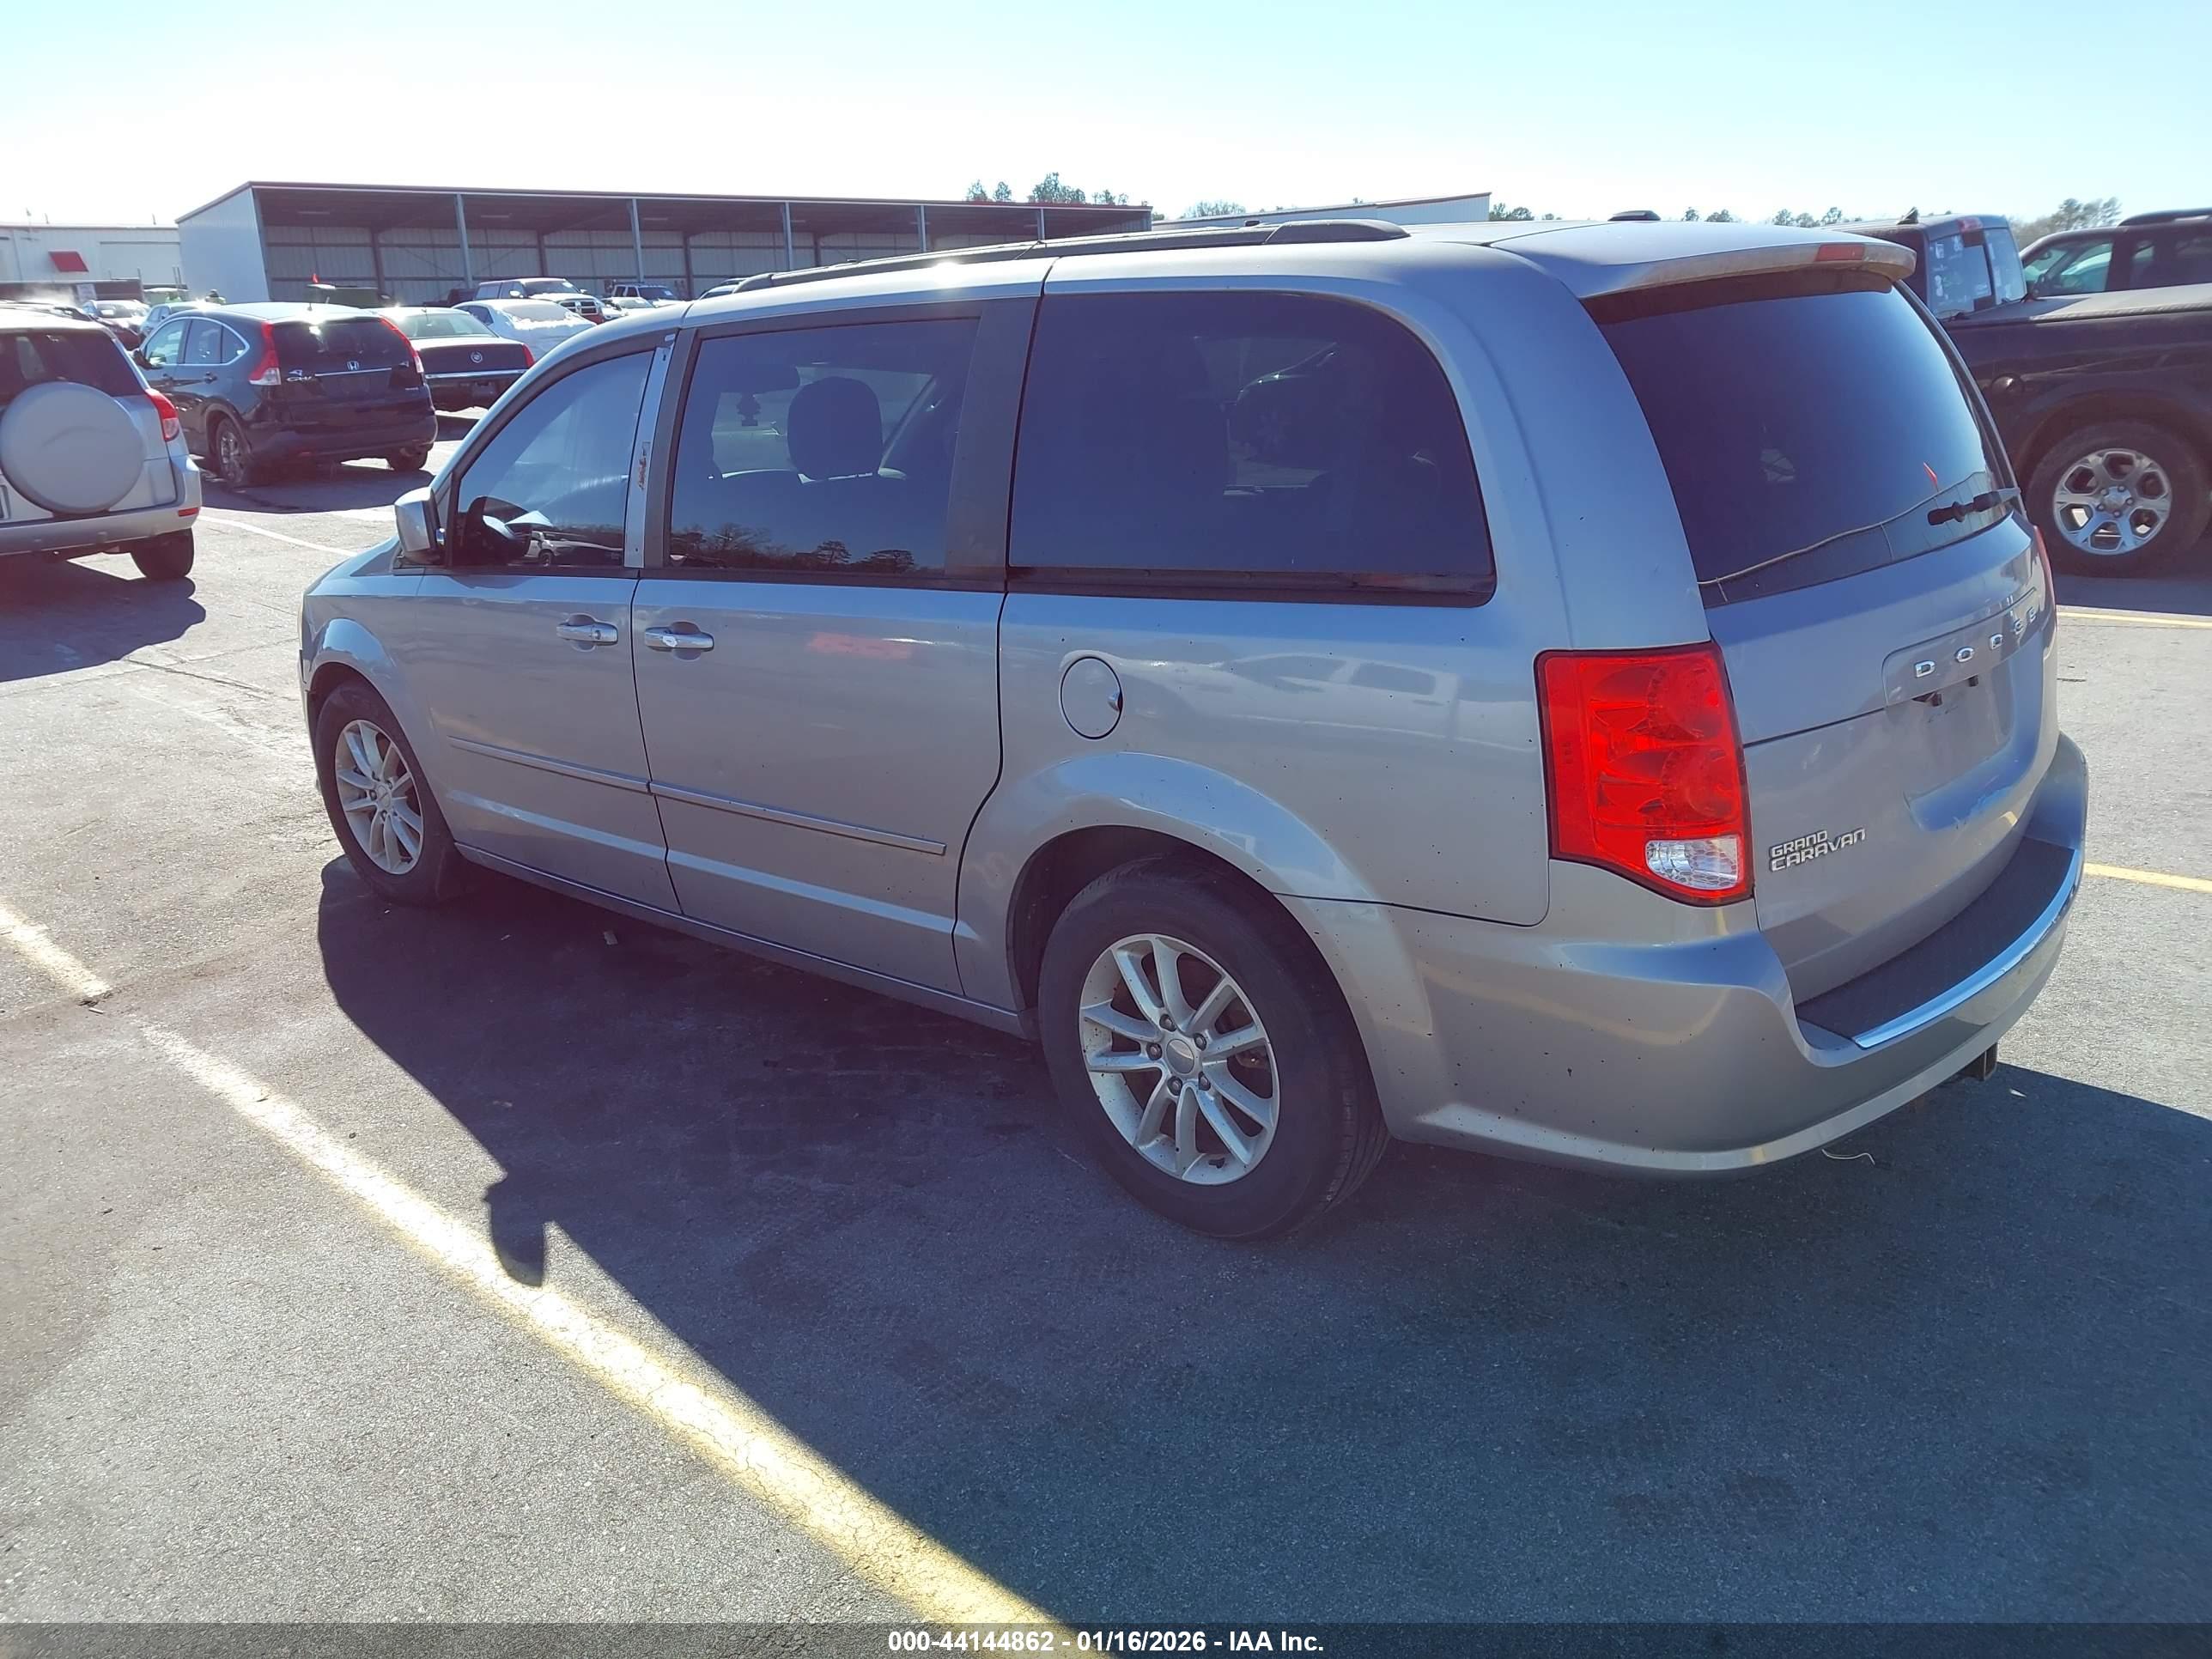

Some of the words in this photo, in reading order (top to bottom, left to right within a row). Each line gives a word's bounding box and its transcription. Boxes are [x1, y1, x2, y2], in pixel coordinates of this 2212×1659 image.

[1913, 606, 2039, 678] DODGE
[1770, 830, 1828, 858] GRAND
[1770, 827, 1867, 872] CARAVAN
